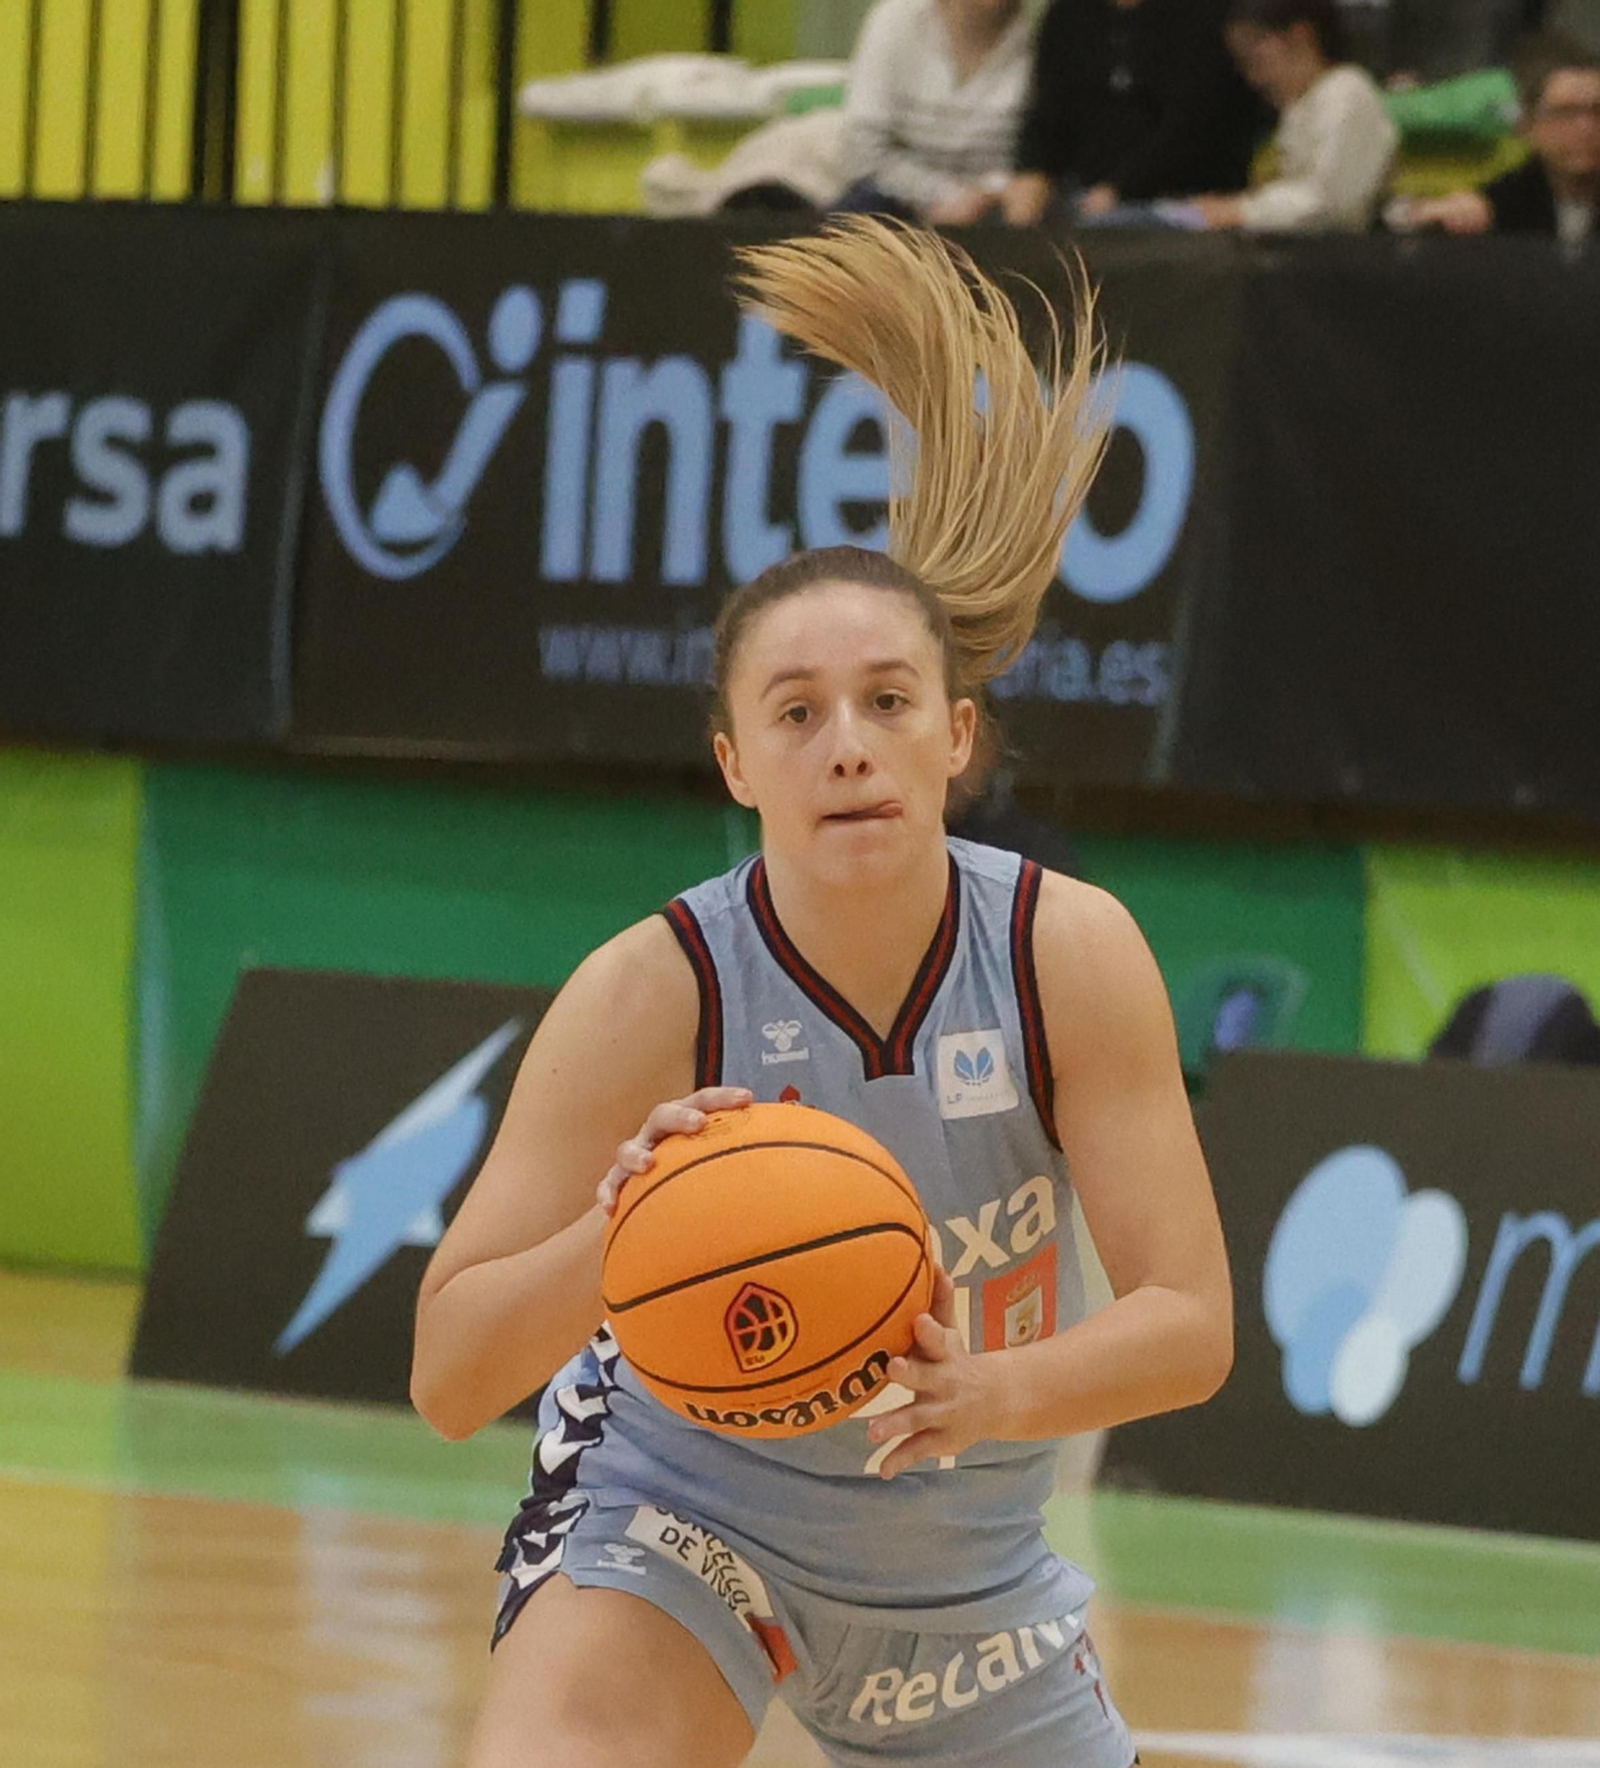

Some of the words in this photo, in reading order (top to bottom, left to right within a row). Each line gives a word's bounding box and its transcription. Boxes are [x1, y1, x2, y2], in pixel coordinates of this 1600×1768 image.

[0, 391, 250, 553] rsa
[928, 1175, 1057, 1279] xa
[659, 1525, 698, 1562] DE
